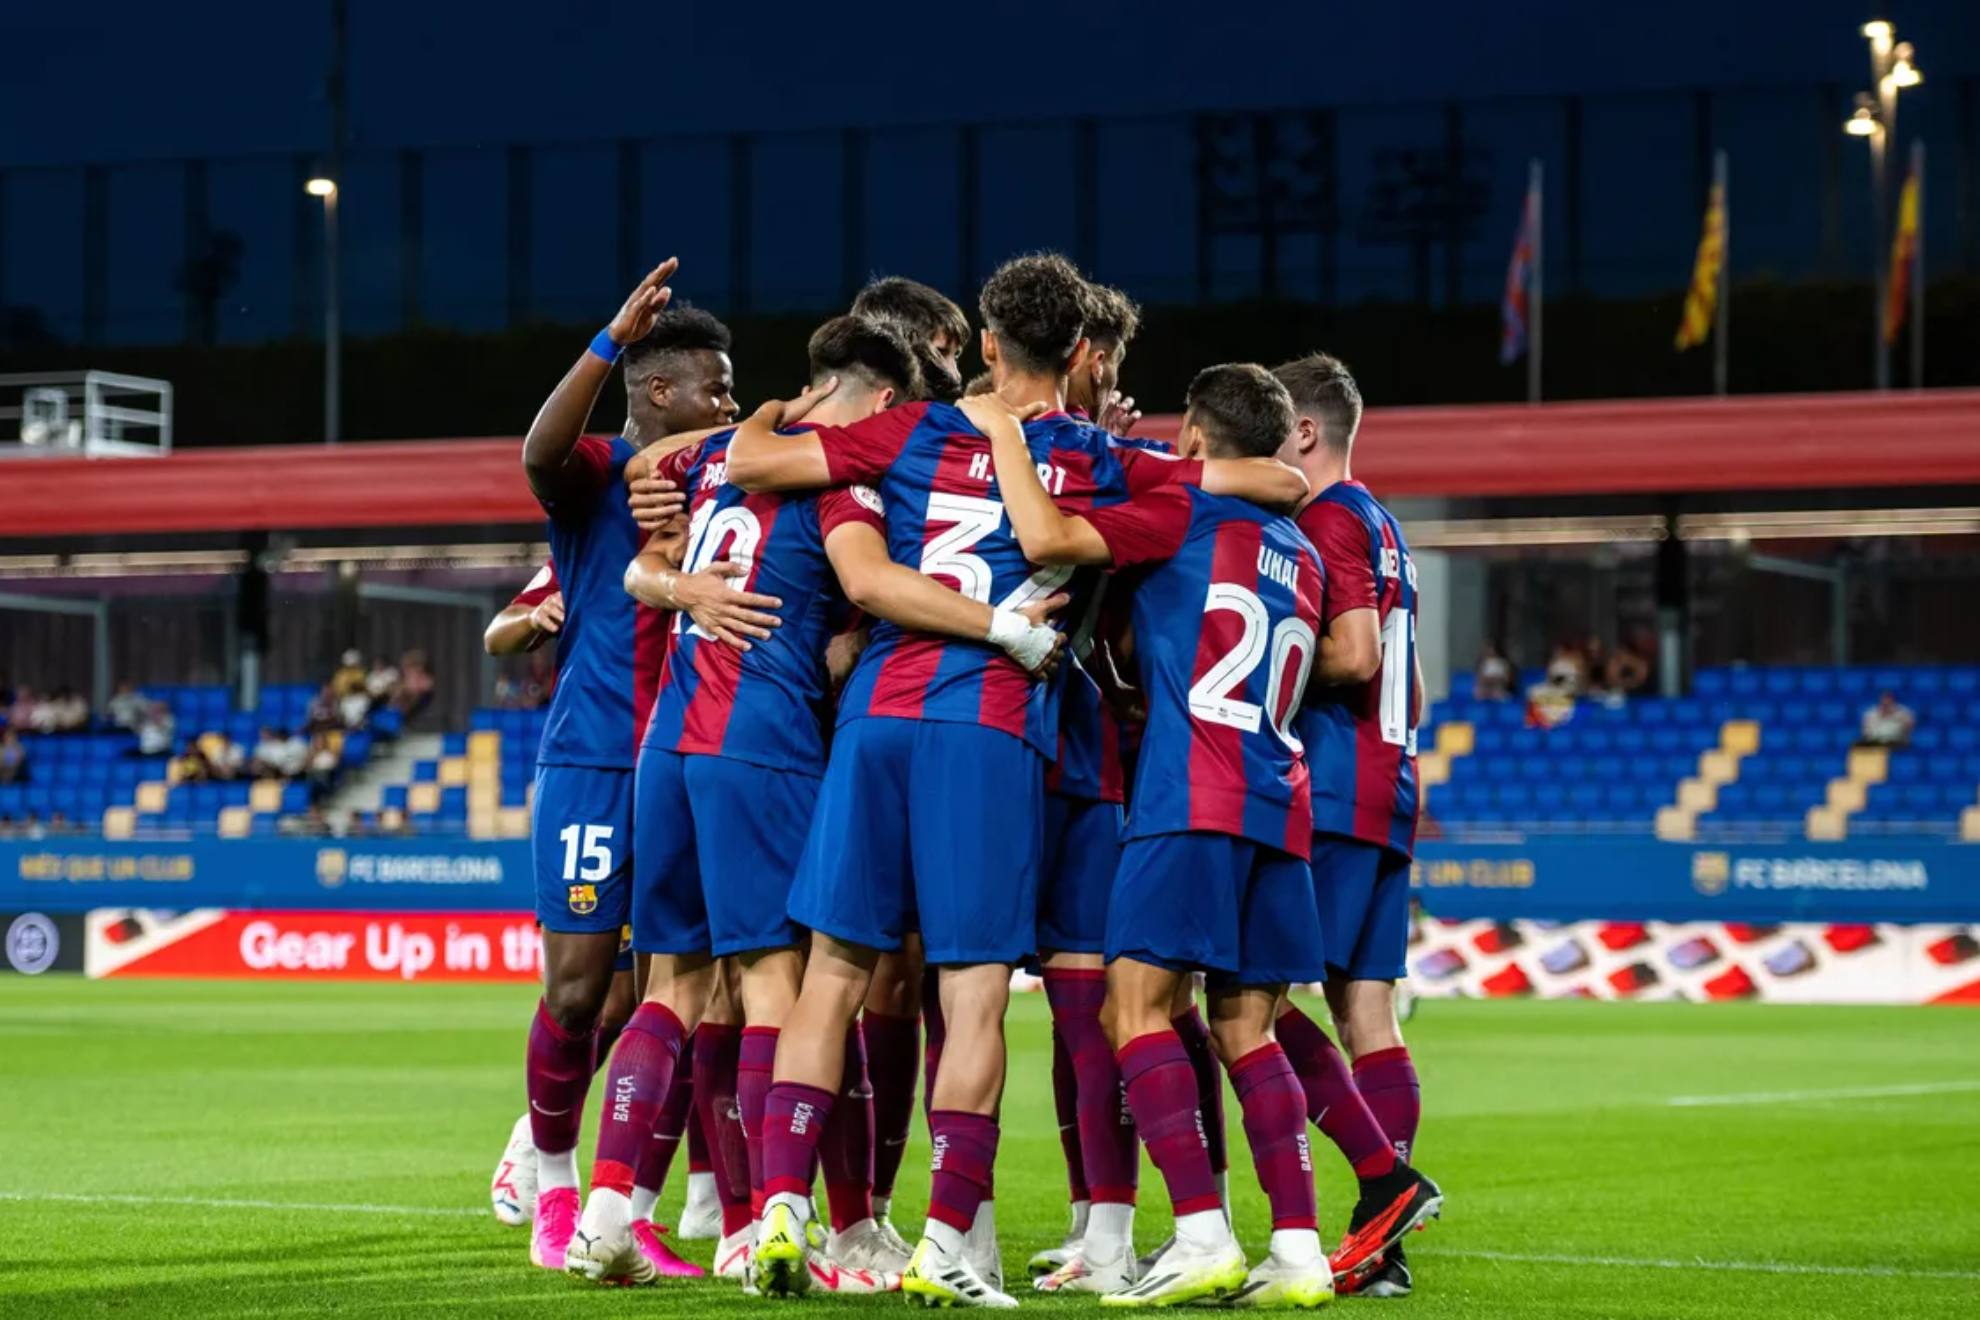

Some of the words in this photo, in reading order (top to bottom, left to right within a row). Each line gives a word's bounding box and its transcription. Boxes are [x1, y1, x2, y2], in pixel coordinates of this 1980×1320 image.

[1188, 582, 1316, 753] 20
[350, 855, 377, 882] FC
[378, 856, 503, 883] BARCELONA
[560, 824, 614, 882] 15
[1470, 859, 1535, 888] CLUB
[1736, 858, 1771, 889] FC
[1773, 858, 1928, 889] BARCELONA
[240, 920, 356, 969] Gear
[365, 922, 435, 980] Up
[444, 923, 490, 971] in
[613, 1075, 637, 1122] BARÇA
[790, 1102, 814, 1135] BARÇA
